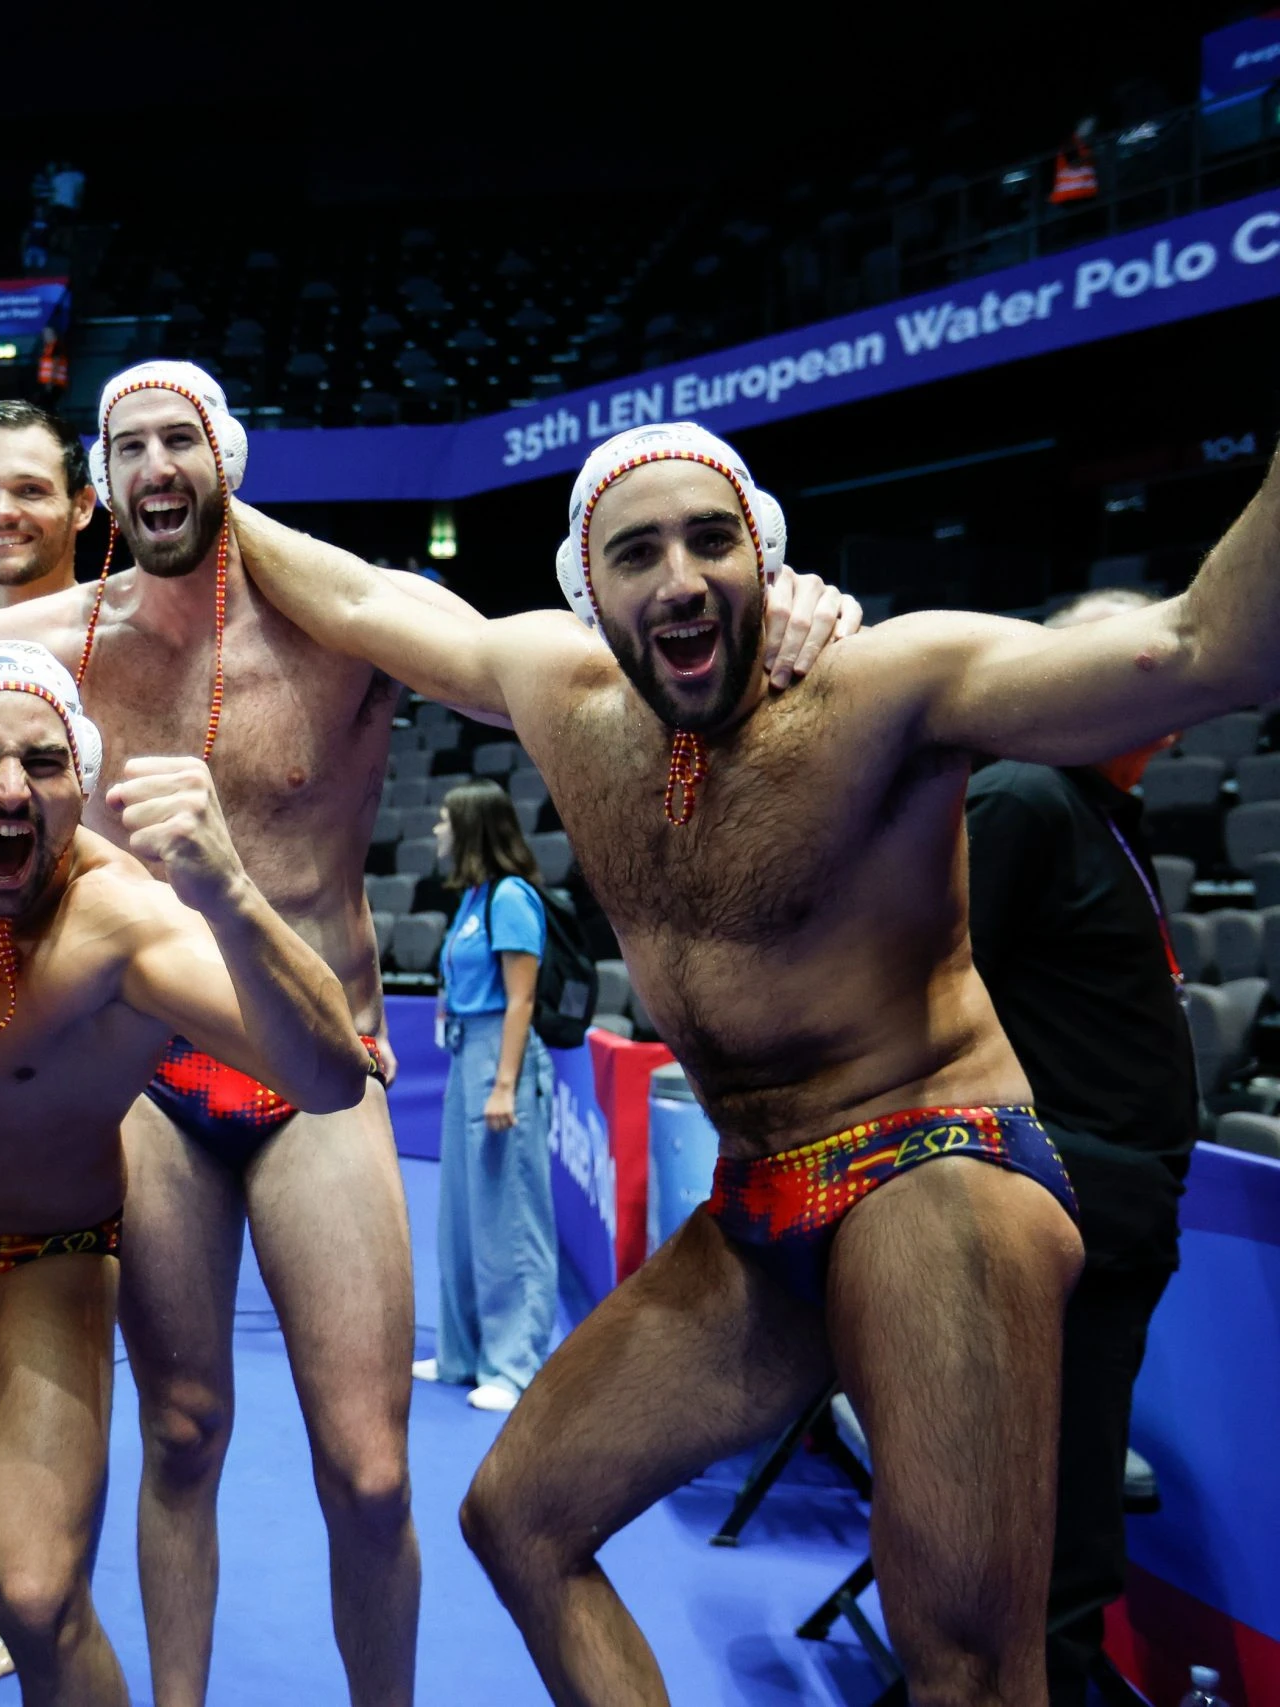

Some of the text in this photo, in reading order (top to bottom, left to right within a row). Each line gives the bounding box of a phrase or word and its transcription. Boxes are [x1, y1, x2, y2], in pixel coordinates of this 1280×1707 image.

[502, 407, 581, 467] 35th
[586, 381, 665, 439] LEN
[671, 331, 887, 417] European
[894, 280, 1065, 357] Water
[1073, 238, 1219, 311] Polo
[1200, 431, 1257, 462] 104
